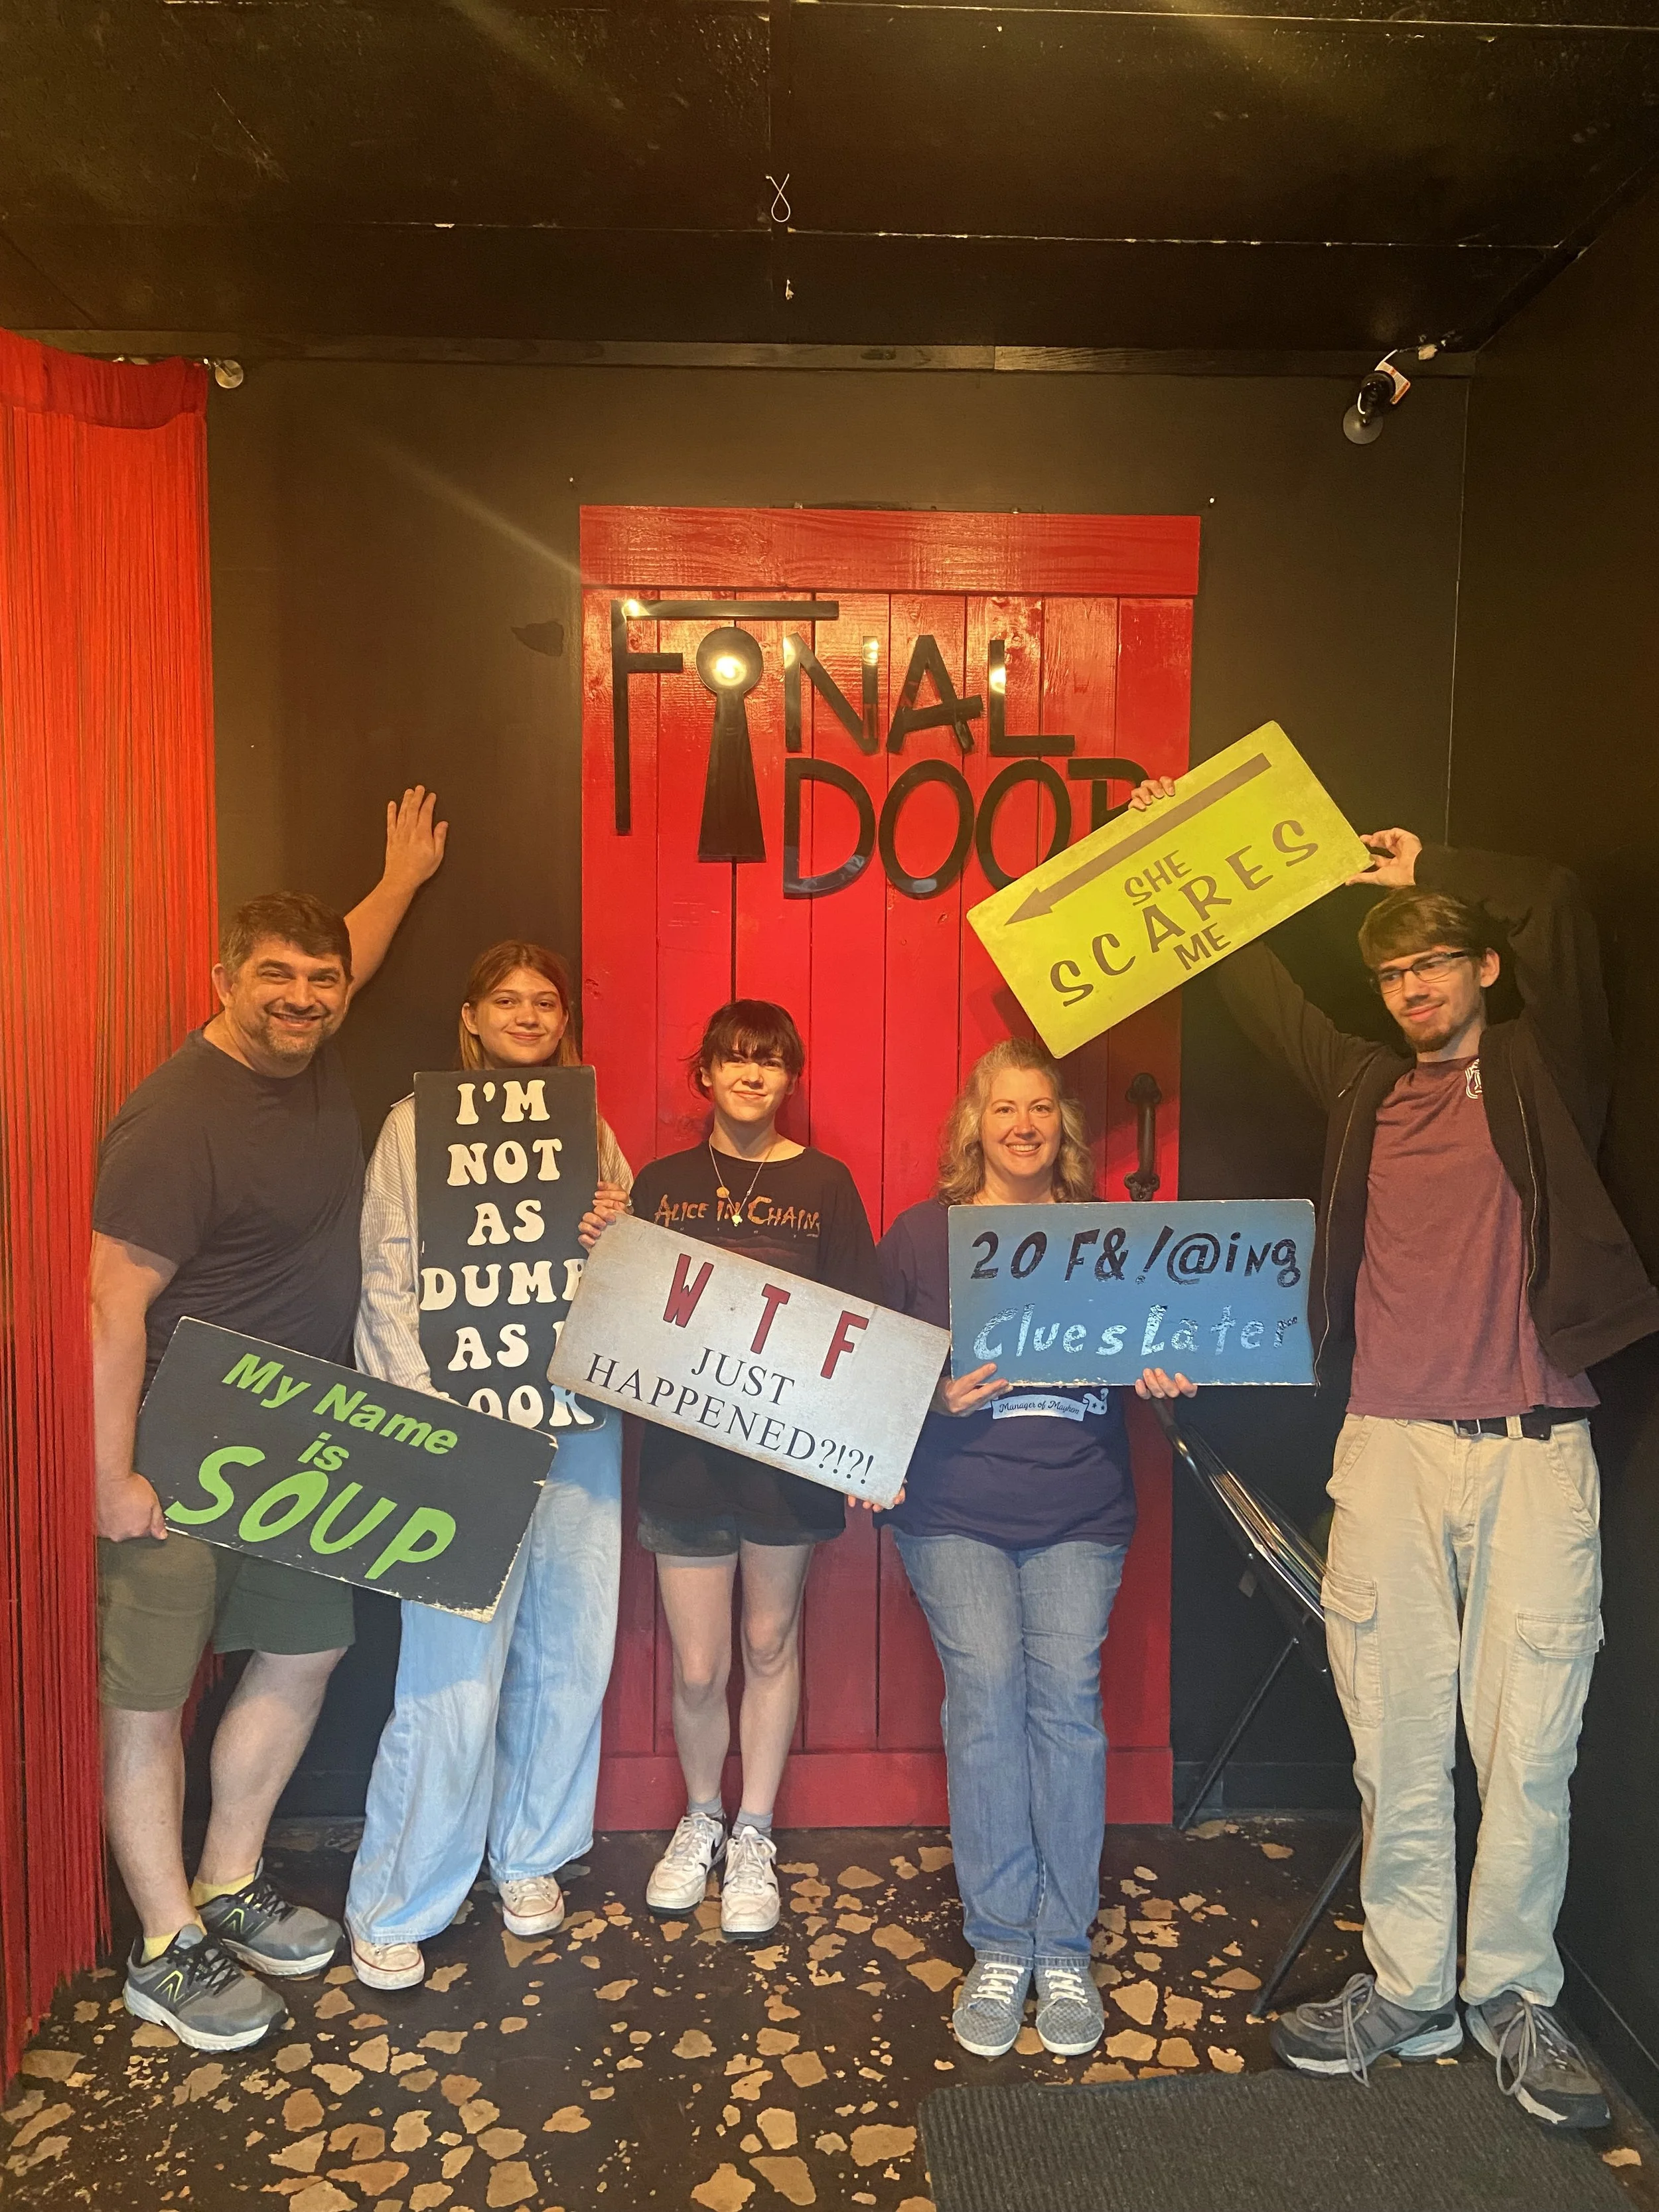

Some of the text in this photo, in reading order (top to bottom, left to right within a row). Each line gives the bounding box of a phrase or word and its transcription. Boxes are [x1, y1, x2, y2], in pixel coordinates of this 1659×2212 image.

[1124, 849, 1192, 906] SHE
[1050, 820, 1319, 1007] SCARES
[1172, 922, 1232, 970] ME
[455, 1079, 551, 1125] I'M
[447, 1138, 563, 1187] NOT
[467, 1199, 545, 1246] AS
[654, 1194, 709, 1227] ALICE
[970, 1230, 1048, 1280] 20
[447, 1323, 530, 1371] AS
[973, 1303, 1299, 1361] Clues Later
[691, 1347, 795, 1406] JUST
[222, 1353, 459, 1455] My Name
[467, 1384, 595, 1428] OOK
[585, 1353, 875, 1485] HAPPENED?!?!
[999, 1402, 1036, 1413] Manager
[1038, 1401, 1046, 1410] of
[297, 1432, 350, 1471] is
[164, 1445, 457, 1580] SOUP
